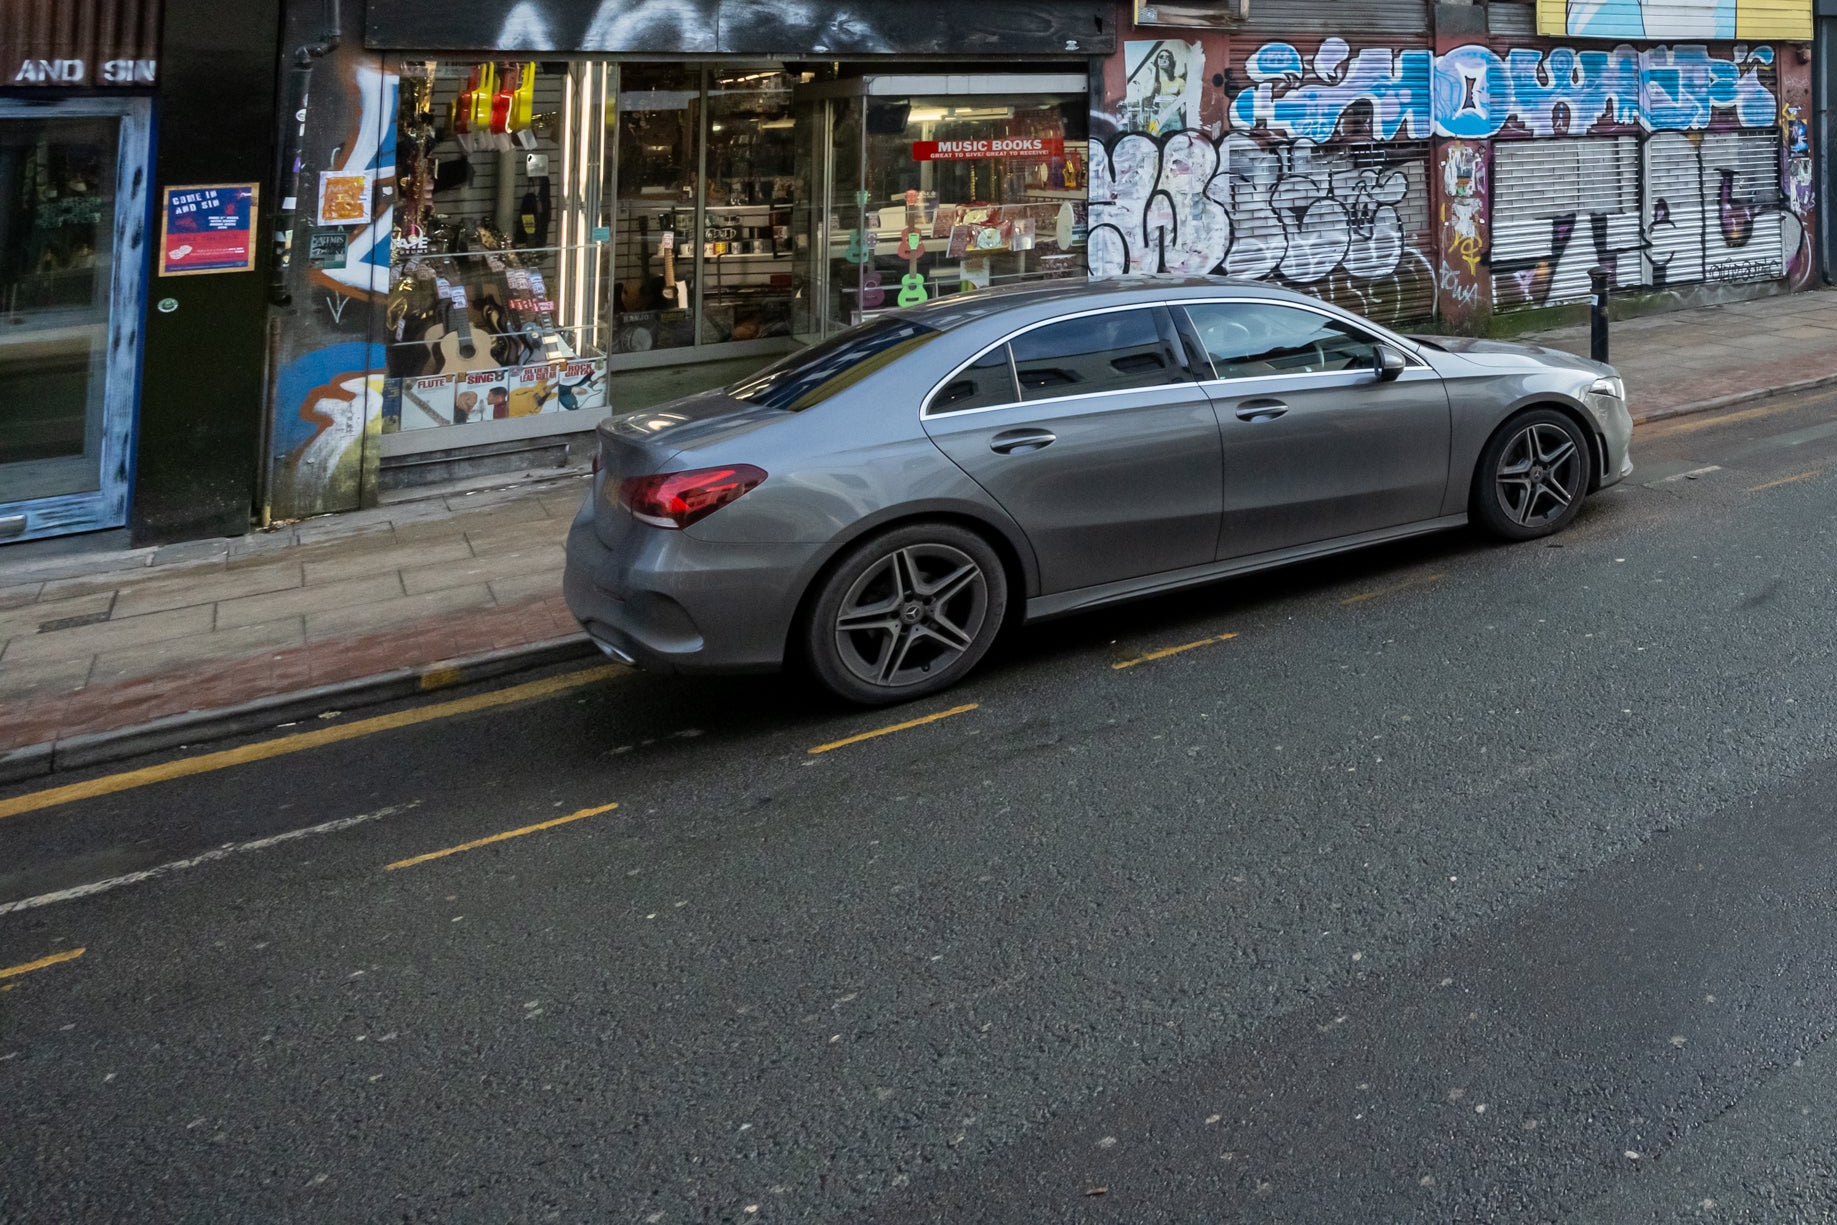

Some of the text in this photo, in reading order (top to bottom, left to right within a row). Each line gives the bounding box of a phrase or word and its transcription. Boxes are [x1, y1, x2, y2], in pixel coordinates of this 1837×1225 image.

[15, 59, 157, 82] AND SIN
[937, 139, 1042, 153] MUSIC BOOKS
[172, 190, 218, 206] COME IN
[175, 199, 220, 215] AND SIN
[568, 363, 593, 372] ROCK
[417, 378, 446, 390] FLUTE
[467, 373, 495, 385] SING
